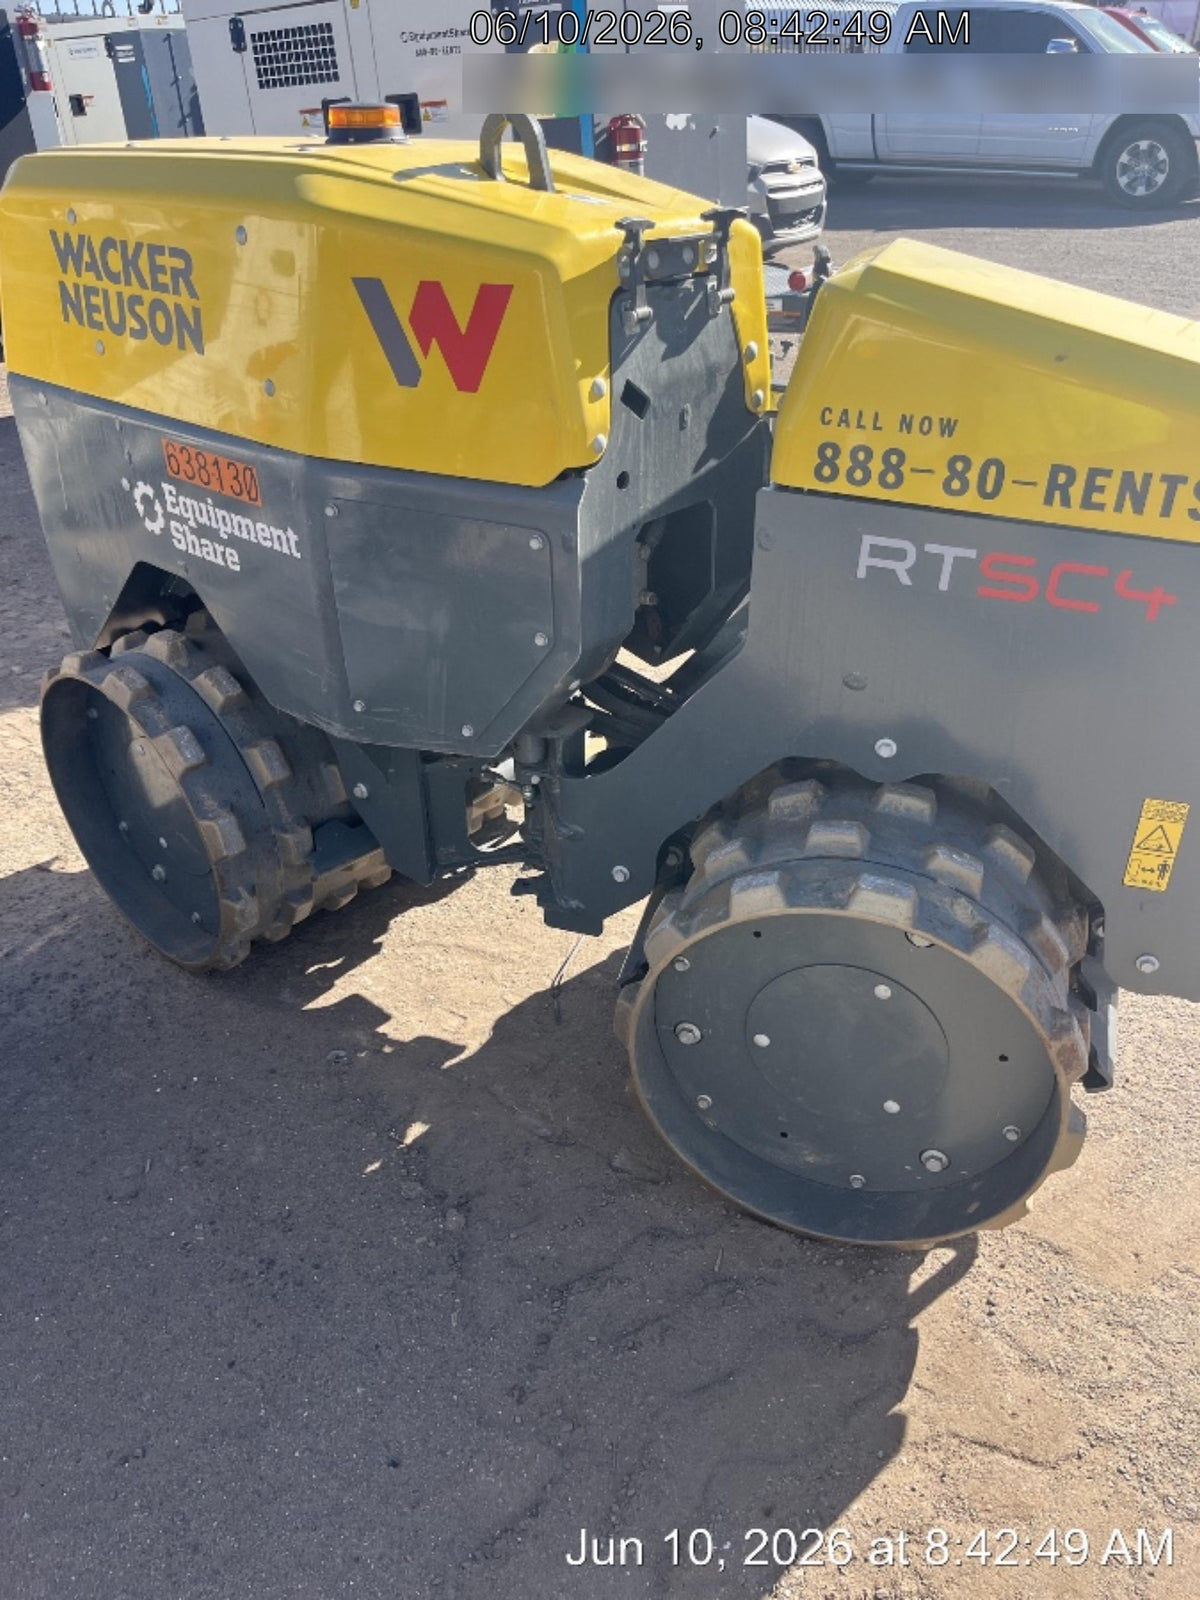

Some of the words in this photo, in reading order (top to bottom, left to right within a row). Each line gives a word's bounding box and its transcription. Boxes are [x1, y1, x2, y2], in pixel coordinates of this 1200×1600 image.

[50, 229, 199, 300] WACKER
[58, 280, 205, 355] NEUSON
[820, 406, 884, 431] CALL
[898, 413, 959, 438] NOW
[165, 443, 258, 502] 638130
[161, 482, 301, 559] Equipment
[170, 520, 241, 571] Share
[857, 534, 1178, 621] RTSC4
